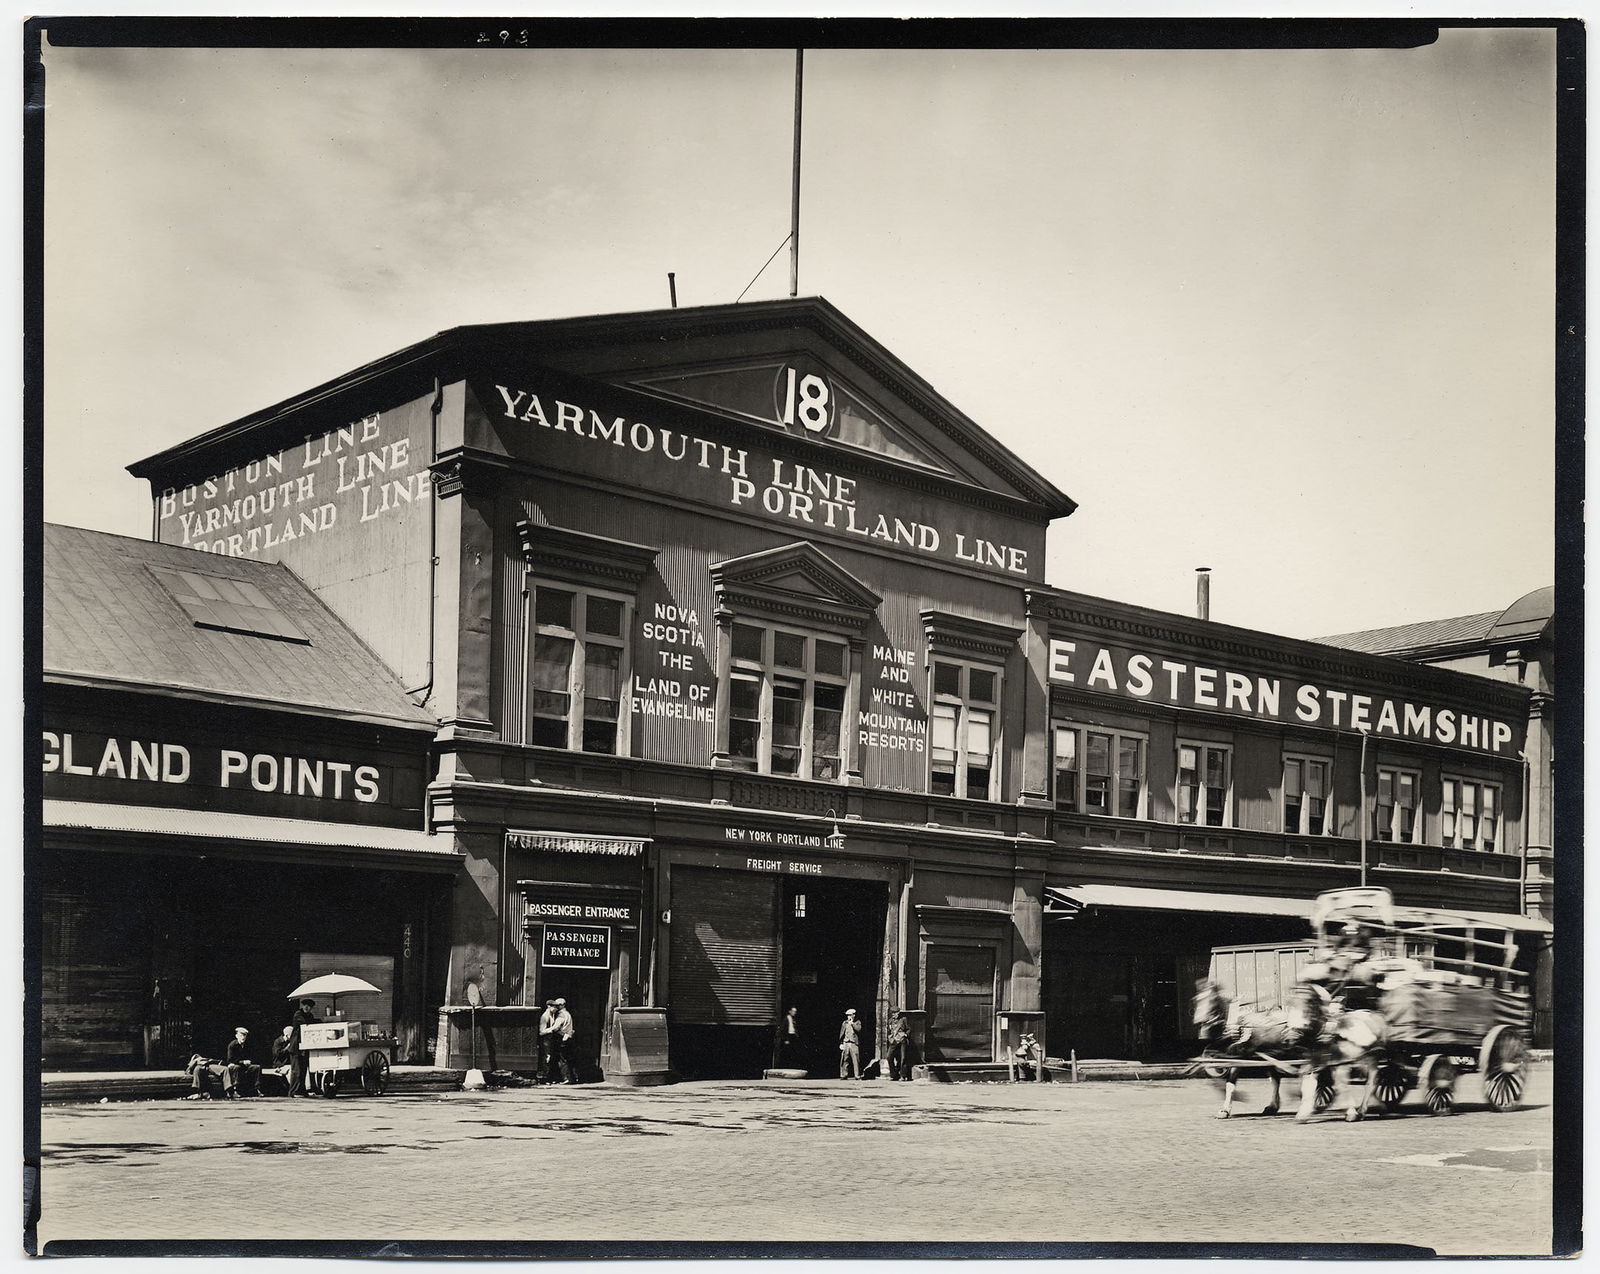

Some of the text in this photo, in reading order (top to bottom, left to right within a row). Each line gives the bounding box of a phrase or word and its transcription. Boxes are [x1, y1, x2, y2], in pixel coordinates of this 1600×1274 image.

[784, 368, 830, 433] 18
[495, 384, 857, 505] YARMOUTH LINE
[160, 411, 381, 520] BOSTON LINE
[178, 438, 410, 546] YARMOUTH LINE
[359, 469, 431, 523] LINE
[730, 477, 1028, 575] PORTLAND LINE
[655, 603, 699, 626] NOVA
[643, 622, 705, 649] SCOTIA
[659, 651, 694, 671] THE
[873, 645, 916, 666] MAINE
[880, 665, 909, 683] AND
[635, 675, 711, 702] LAND OF
[872, 687, 915, 708] WHITE
[1048, 639, 1513, 752] EASTERN STEAMSHIP
[631, 697, 715, 722] EVANGELINE
[859, 711, 926, 734] MOUNTAIN
[859, 730, 924, 752] RESORTS
[43, 731, 380, 803] GLAND POINTS
[725, 828, 845, 849] NEW YORK PORTLAND LINE
[746, 858, 822, 873] FREIGHT SERVICE
[529, 903, 630, 919] PASSENGER ENTRANCE
[546, 931, 605, 944] PASSENGER
[551, 946, 600, 958] ENTRANCE
